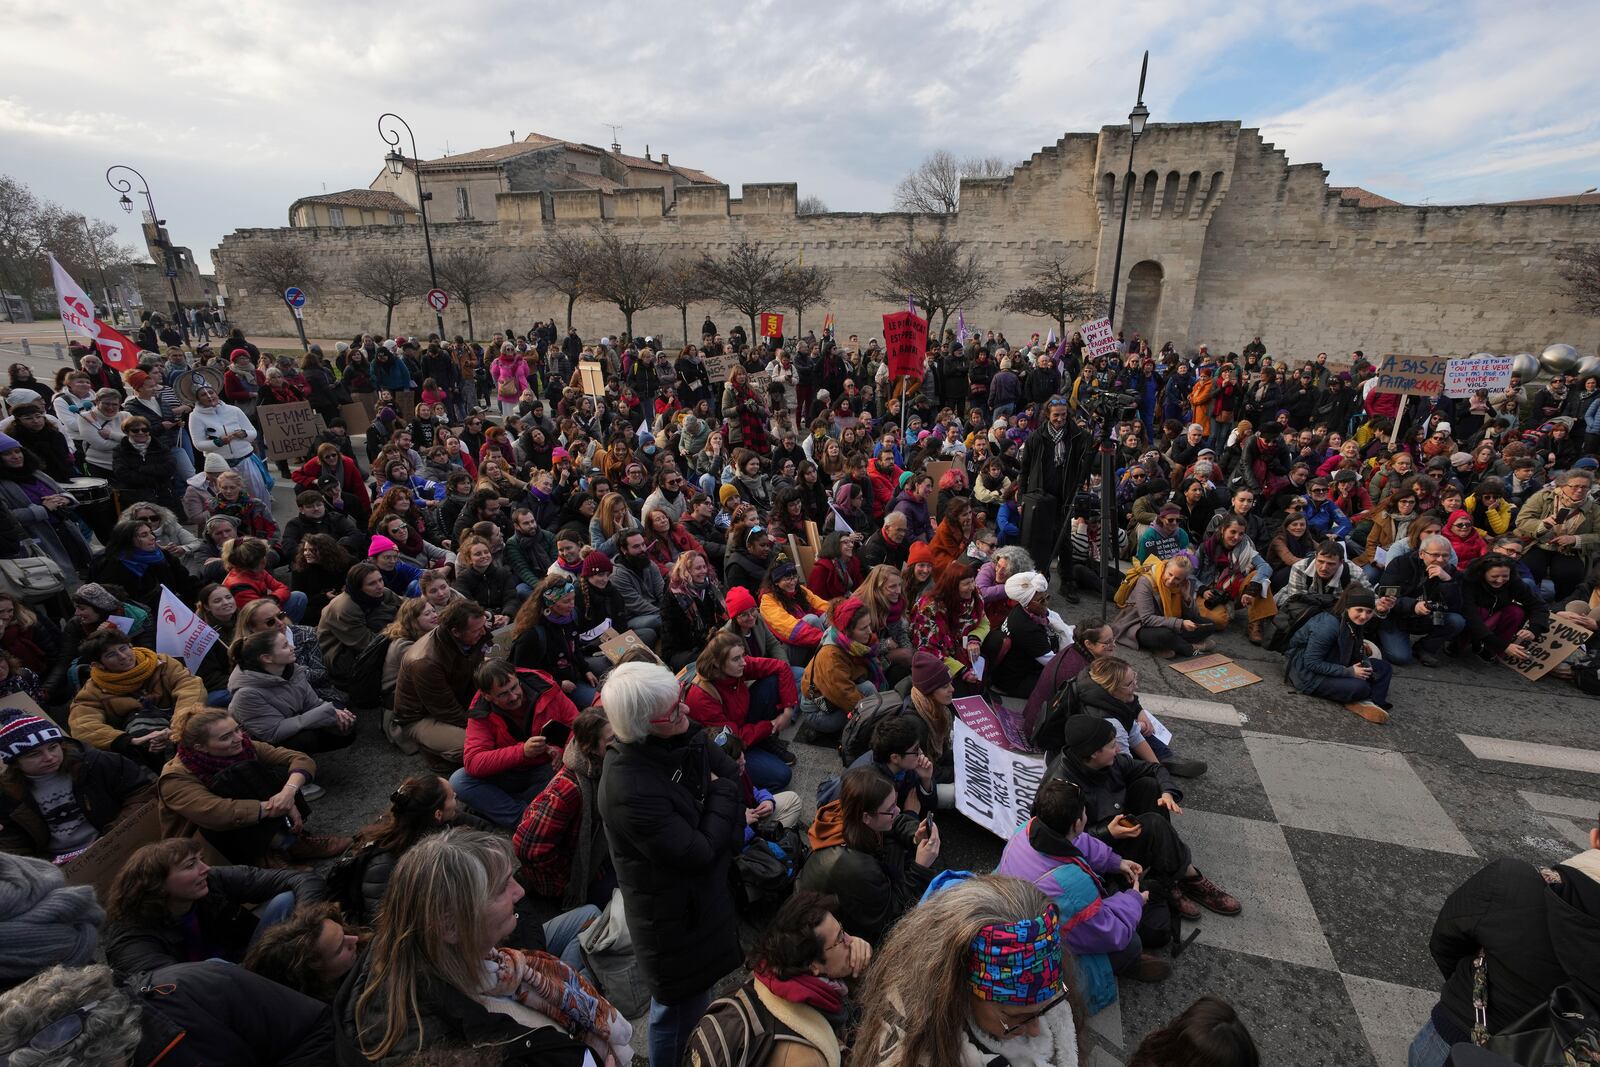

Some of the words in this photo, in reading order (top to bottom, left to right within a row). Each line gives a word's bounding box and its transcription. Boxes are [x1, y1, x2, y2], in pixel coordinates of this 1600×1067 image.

[1099, 328, 1109, 337] TE
[1400, 359, 1428, 374] BAS
[1429, 360, 1446, 375] LE
[266, 408, 312, 426] FEMME
[280, 423, 306, 436] VIE
[272, 436, 314, 454] LIBERT
[964, 737, 994, 820] L'HONNEUR
[993, 782, 1010, 808] FACE
